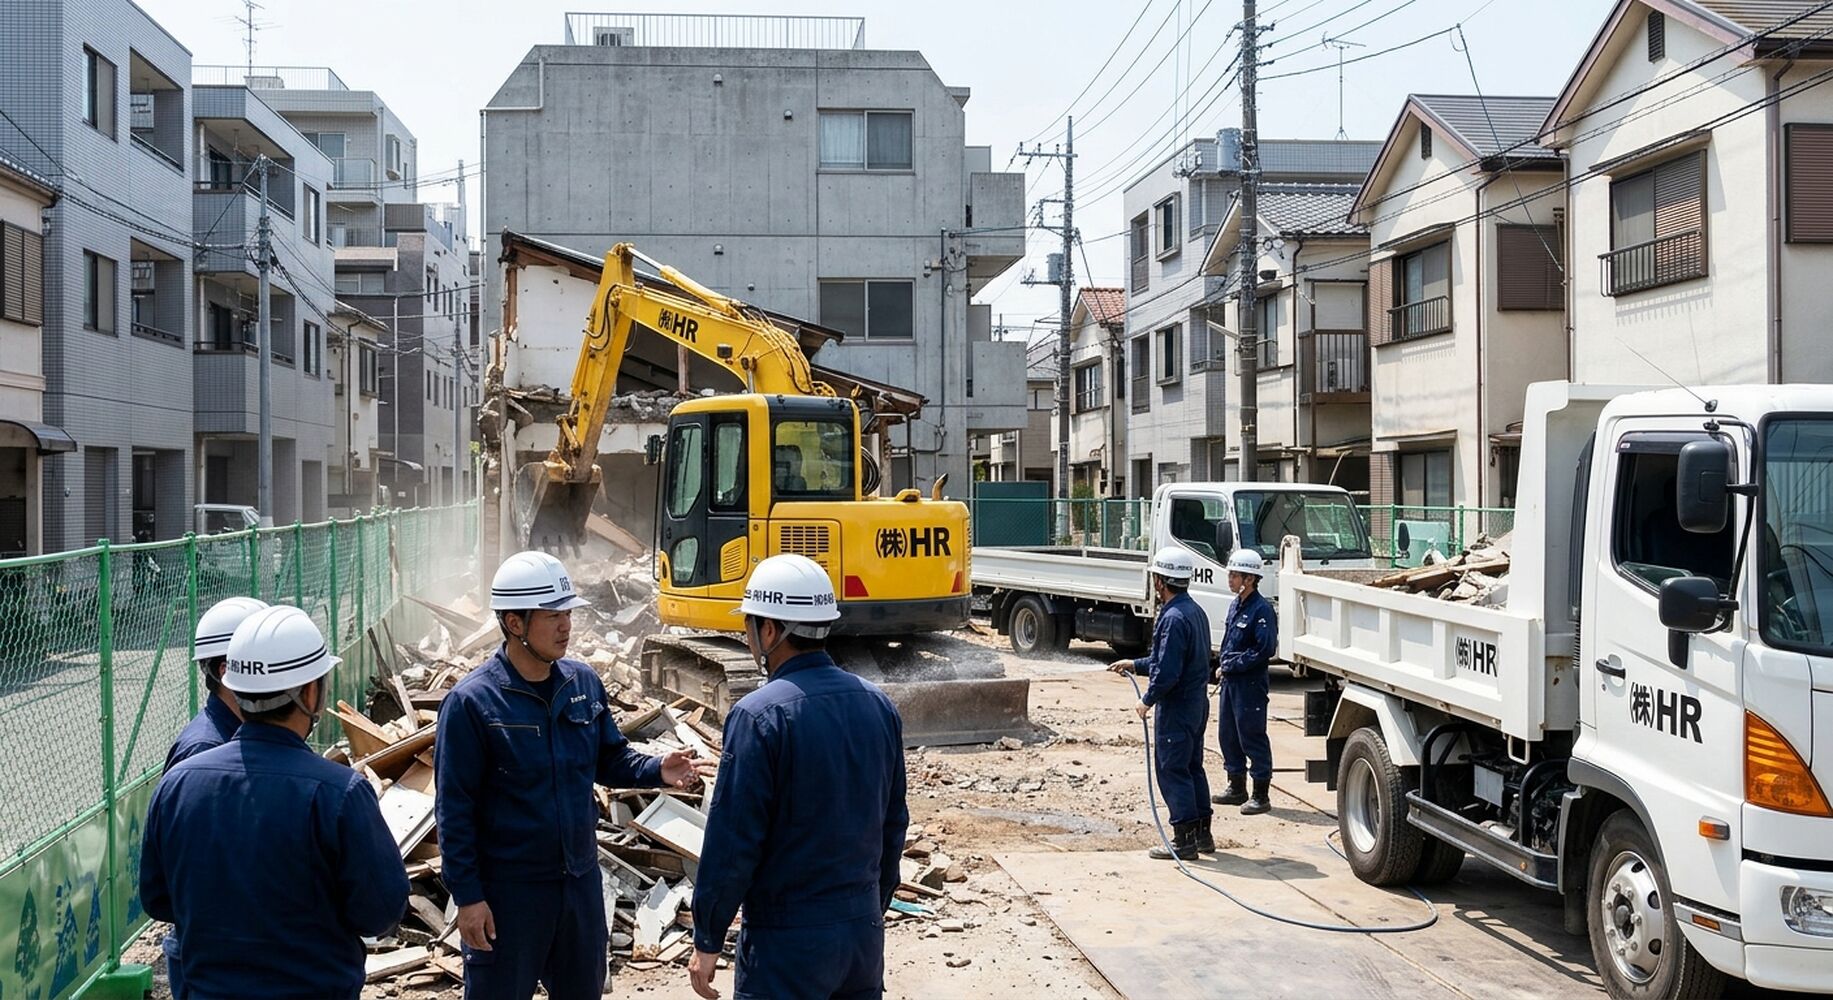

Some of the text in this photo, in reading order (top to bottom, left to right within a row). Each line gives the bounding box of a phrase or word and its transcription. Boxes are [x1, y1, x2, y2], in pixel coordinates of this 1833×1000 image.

[875, 527, 952, 558] (株)HR
[1191, 568, 1213, 584] HR
[1630, 682, 1703, 744] (株)HR
